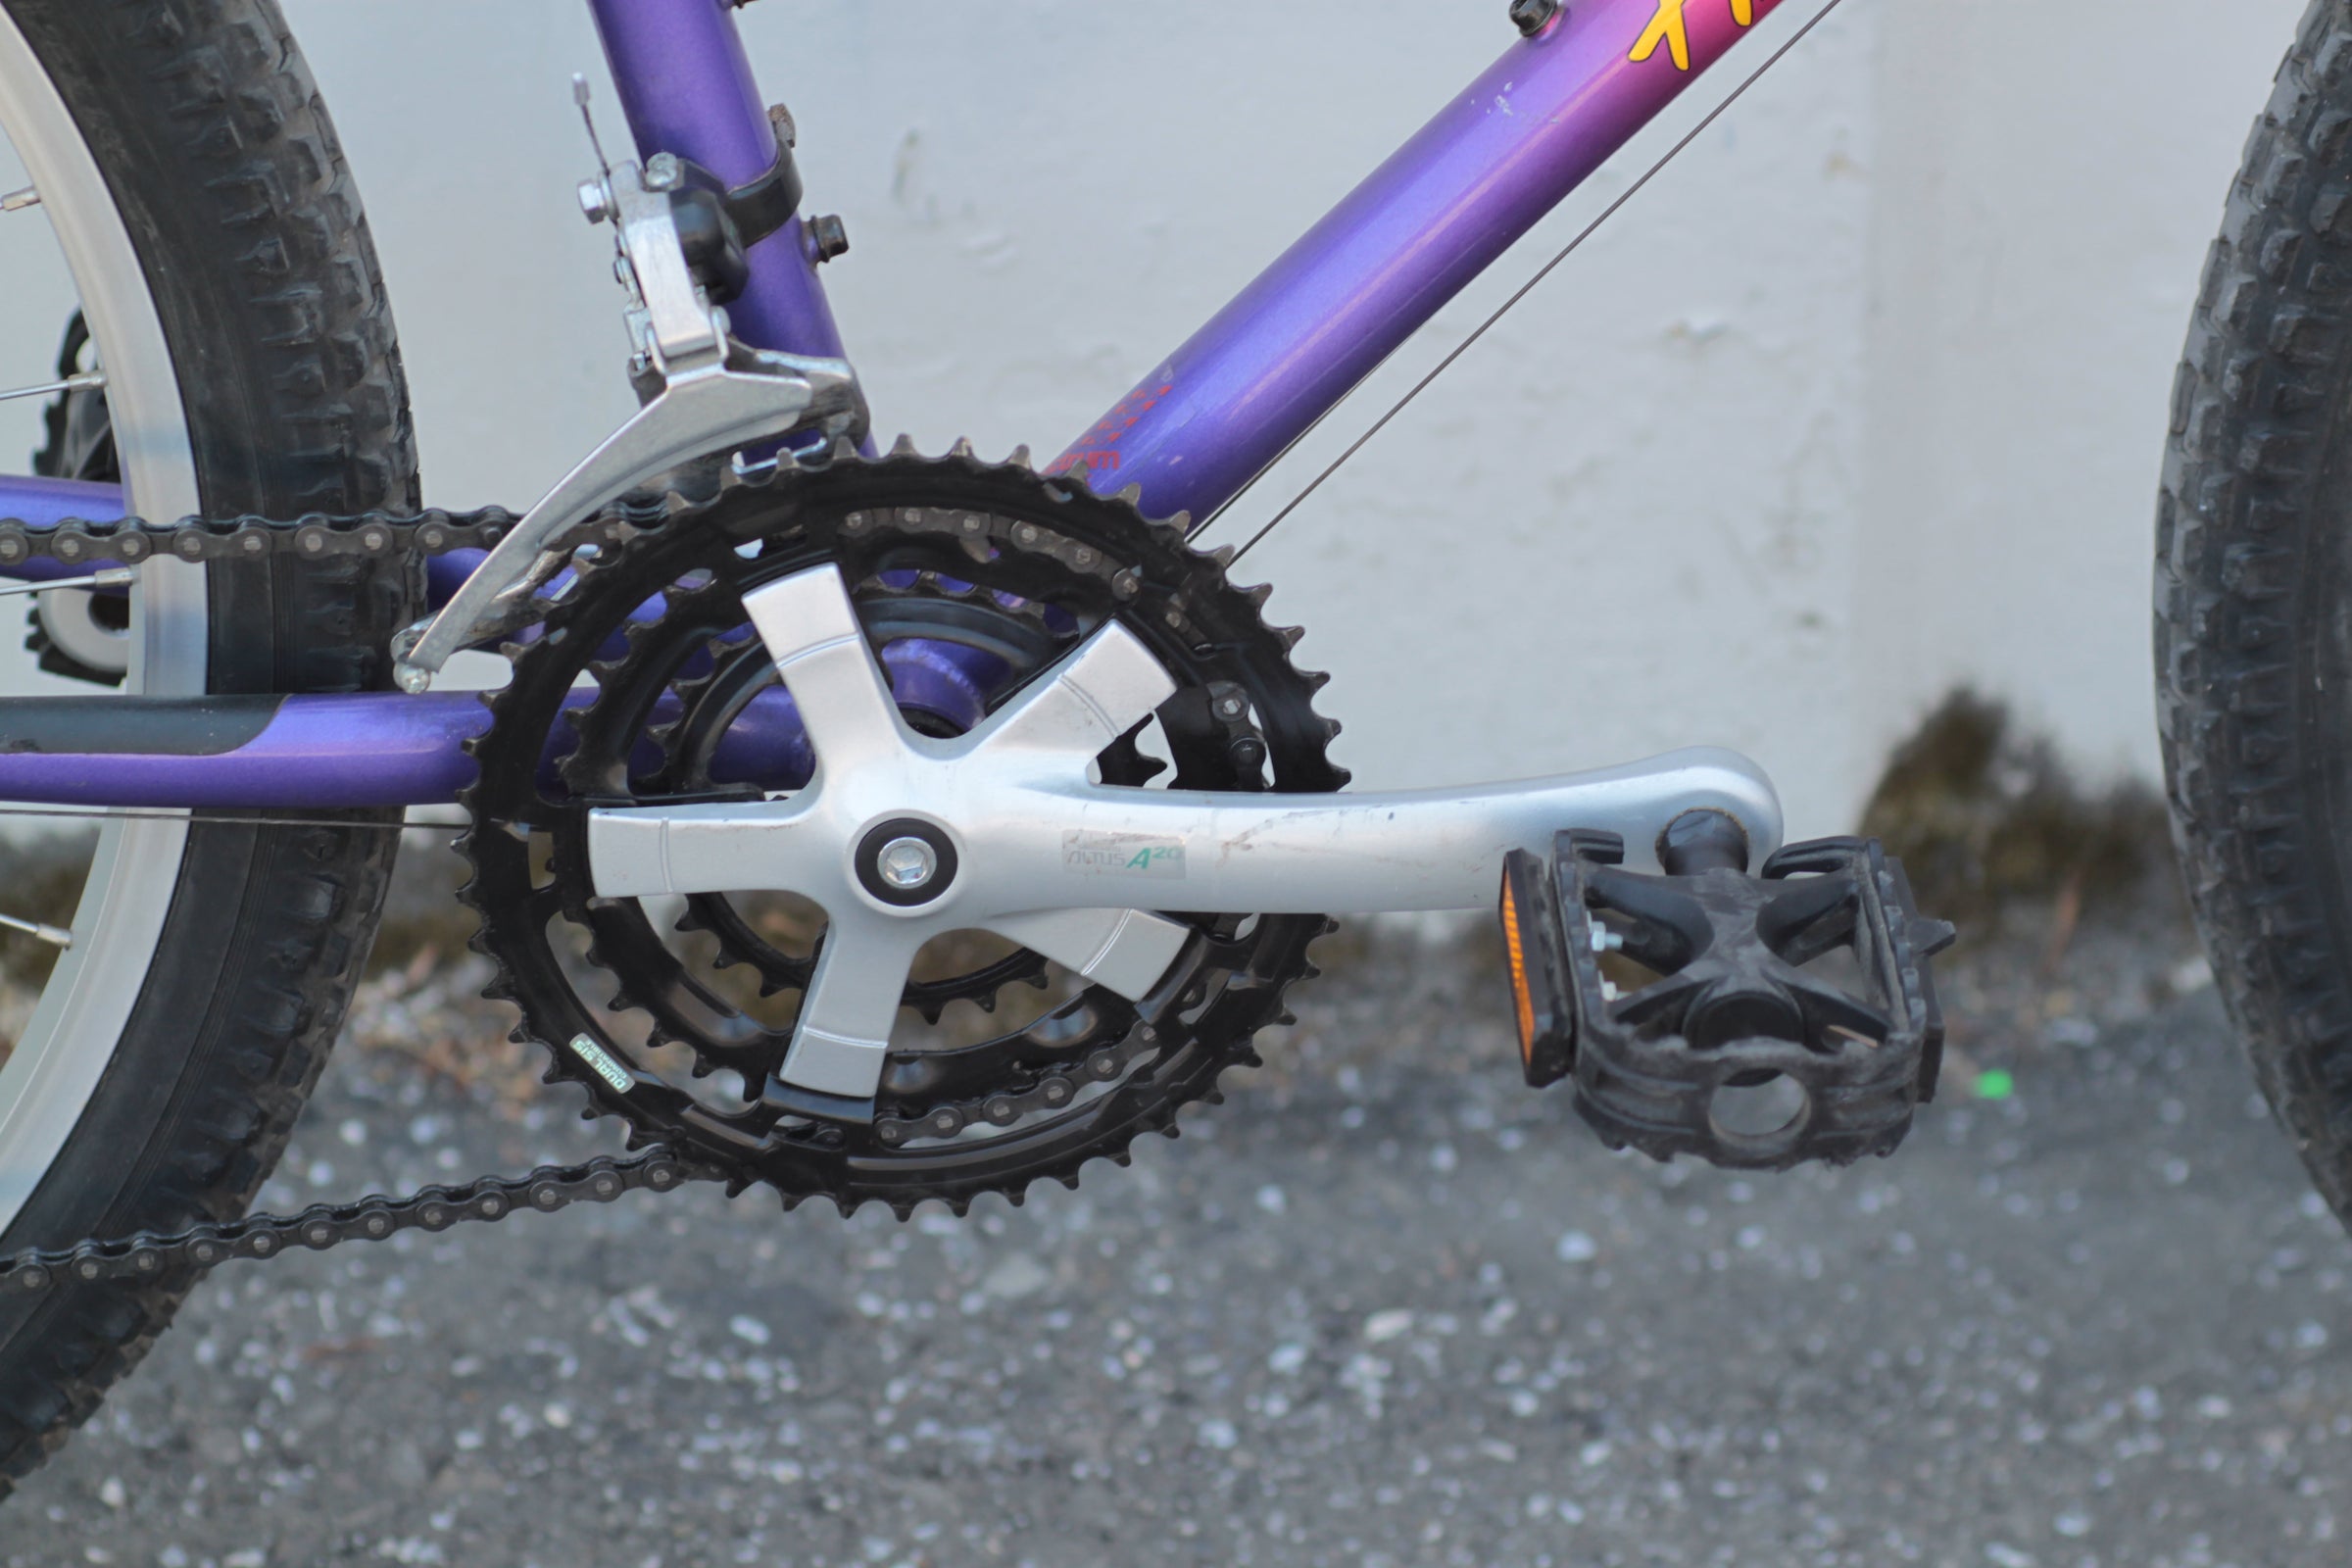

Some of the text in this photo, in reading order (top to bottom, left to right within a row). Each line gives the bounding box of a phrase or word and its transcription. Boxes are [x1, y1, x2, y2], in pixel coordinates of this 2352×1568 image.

[1067, 850, 1126, 867] ALTUS
[1126, 845, 1182, 870] A20
[572, 1040, 626, 1090] DUAL SIS
